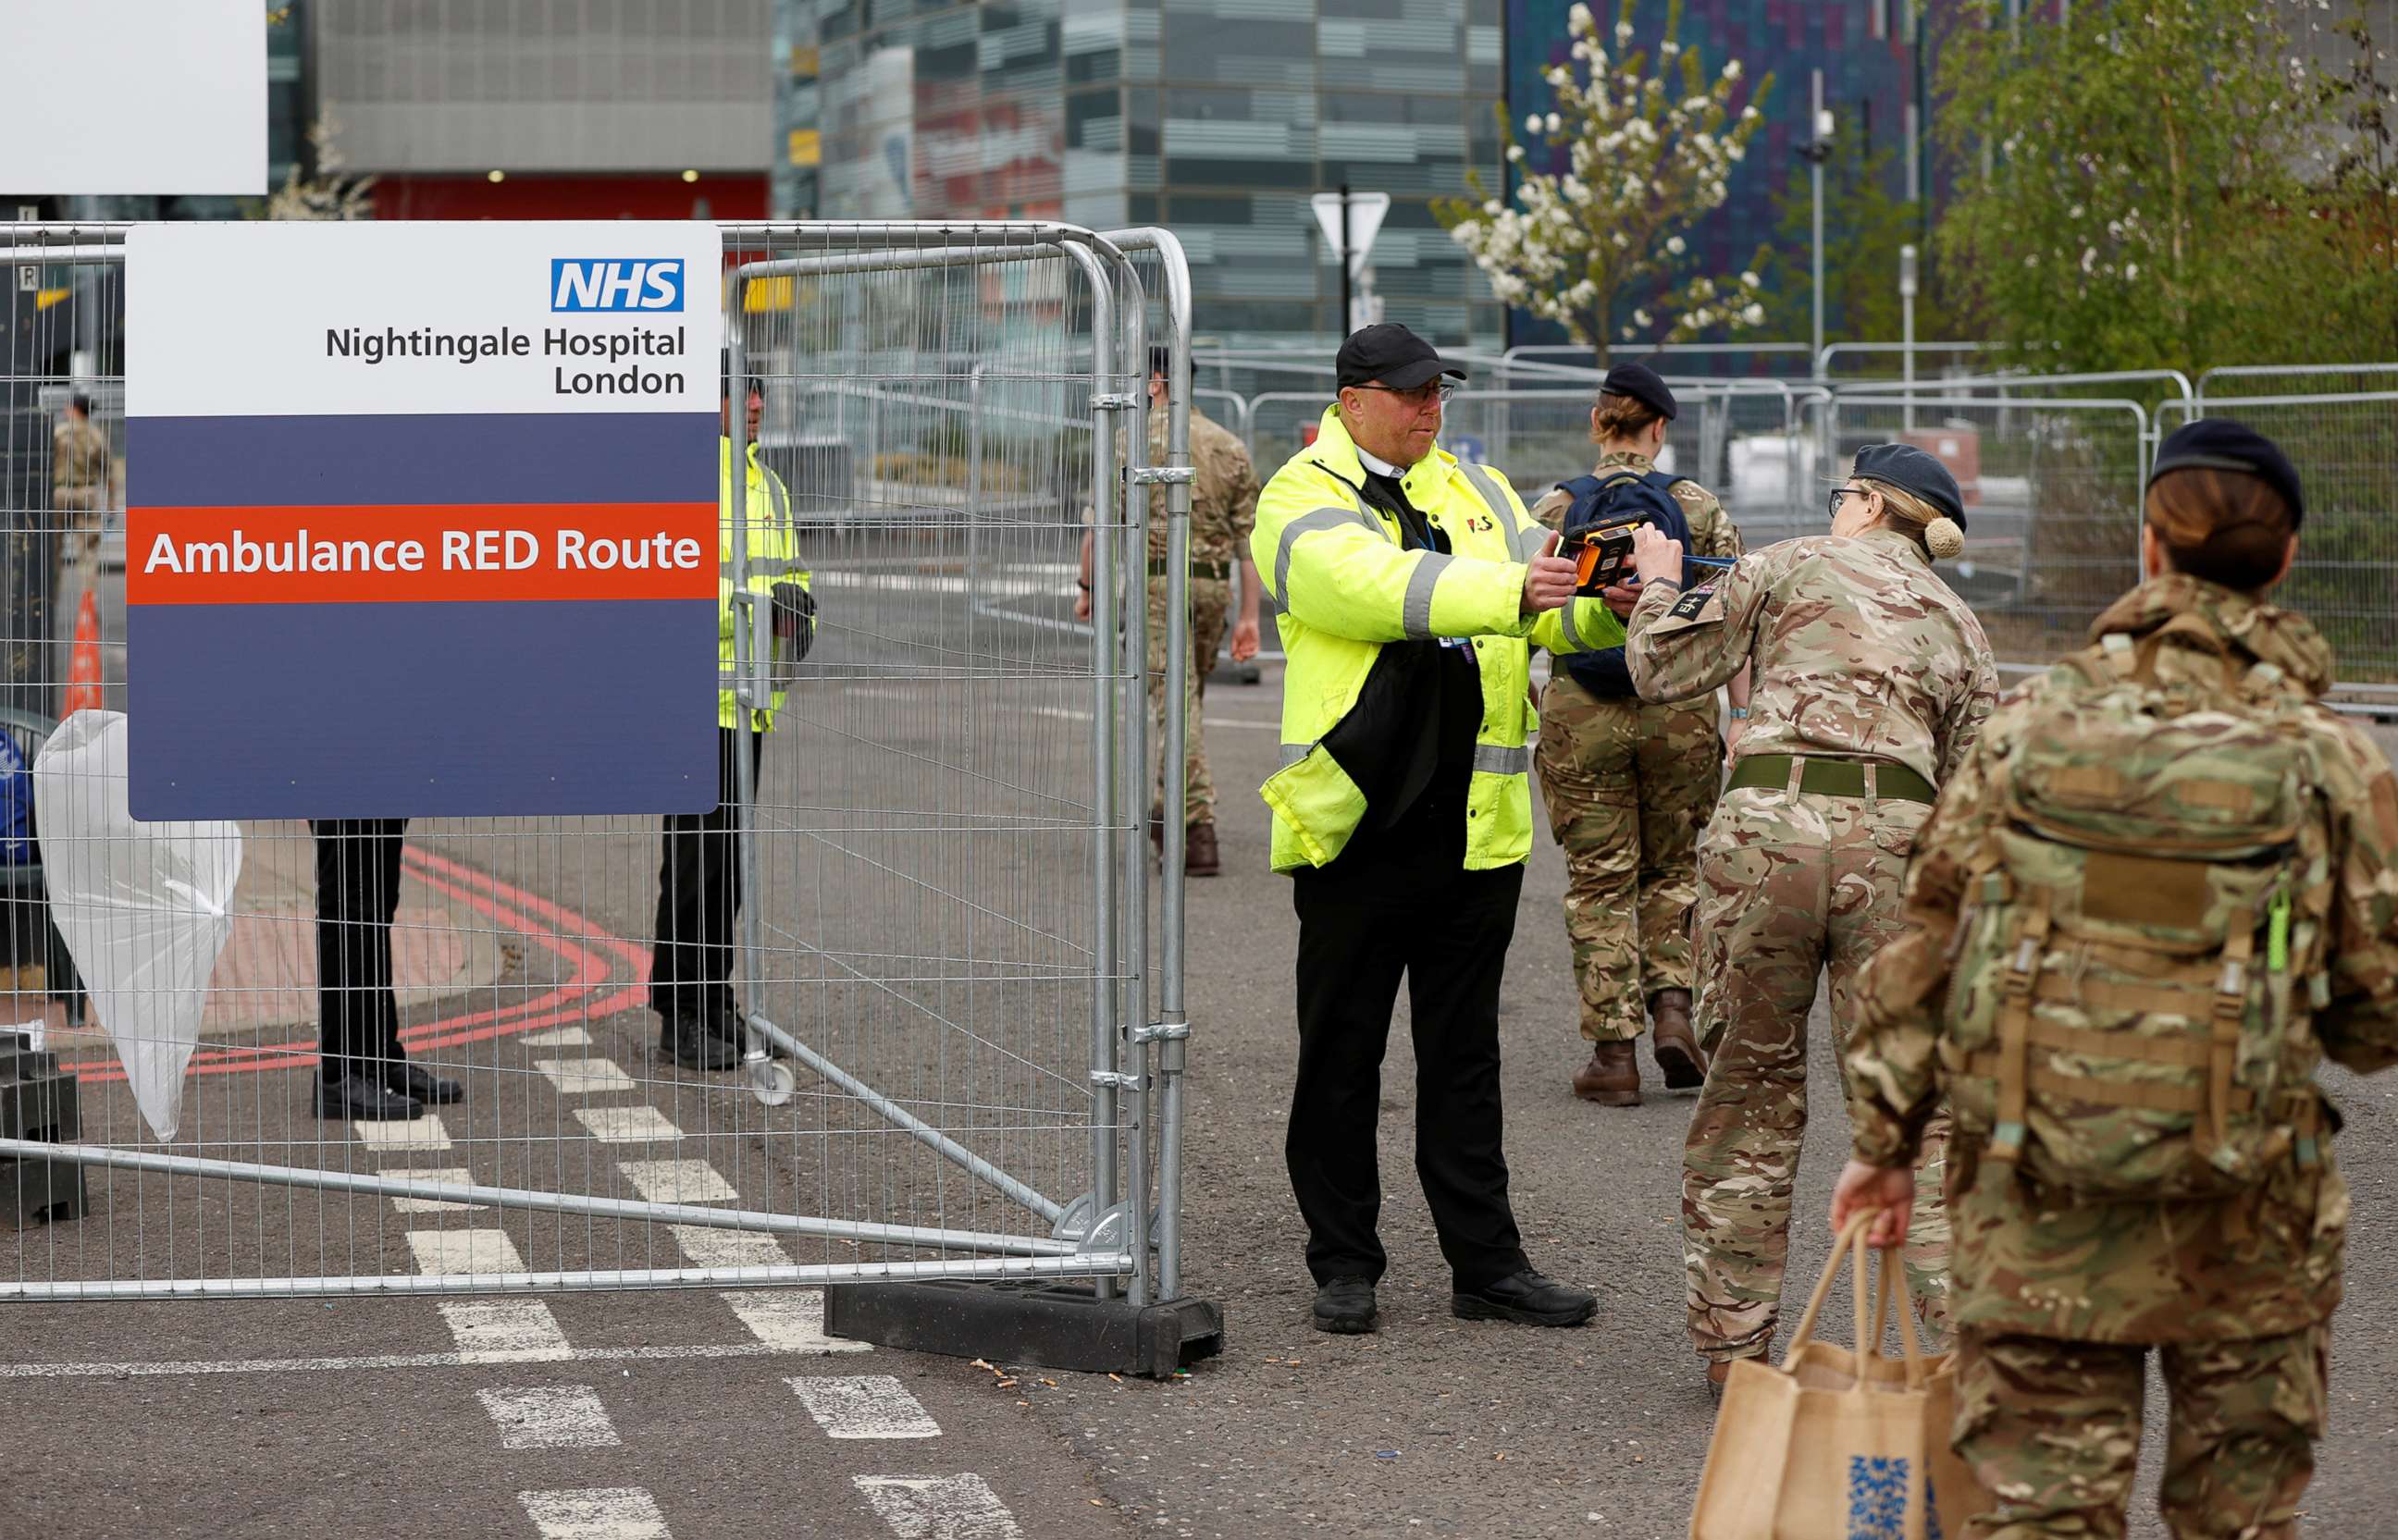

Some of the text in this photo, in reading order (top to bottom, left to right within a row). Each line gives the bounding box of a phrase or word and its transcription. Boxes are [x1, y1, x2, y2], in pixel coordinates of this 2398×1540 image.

[554, 262, 680, 309] NHS
[327, 326, 685, 364] Nightingale Hospital
[555, 364, 685, 395] London
[143, 530, 701, 573] Ambulance RED Route
